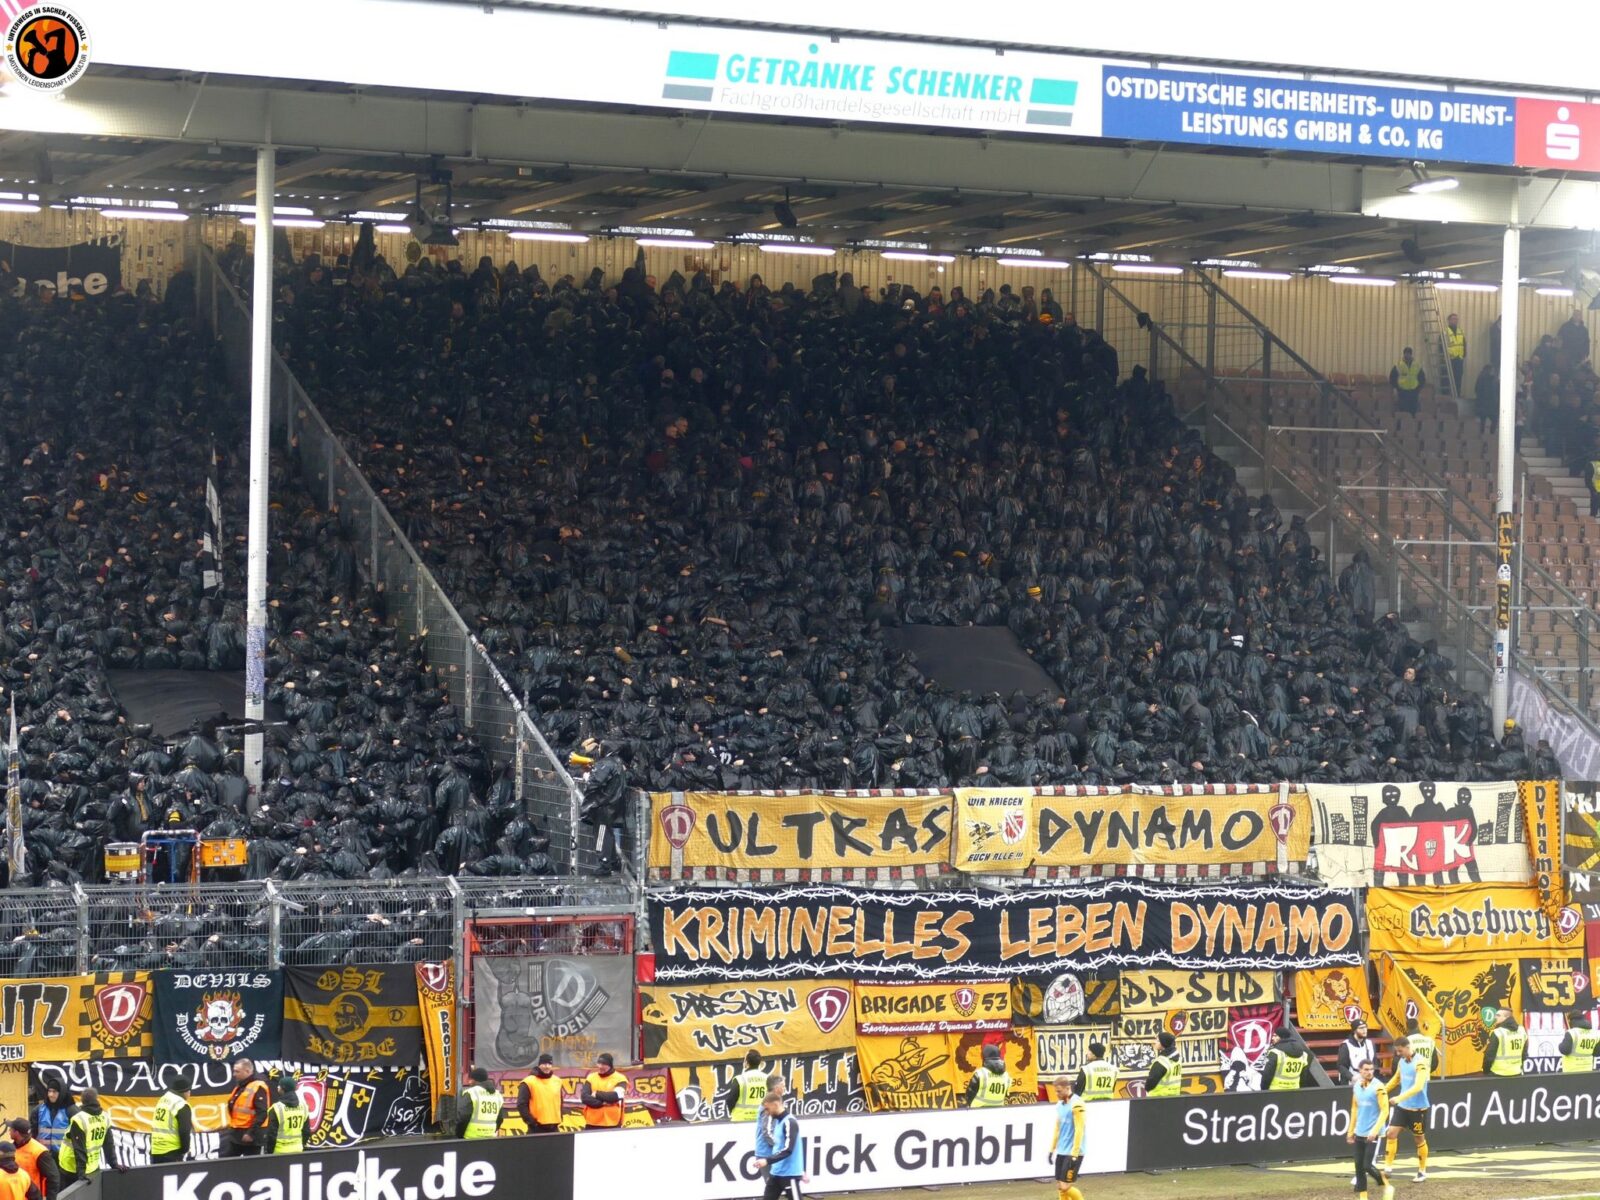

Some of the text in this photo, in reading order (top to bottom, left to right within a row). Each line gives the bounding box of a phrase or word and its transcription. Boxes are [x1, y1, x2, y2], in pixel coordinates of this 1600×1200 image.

[886, 66, 1023, 102] SCHENKER
[720, 88, 1021, 124] Fachgroßhandelsgesellschaft mbH
[1106, 76, 1513, 127] OSTDEUTSCHE SICHERHEITS- UND DIENST-
[1181, 110, 1444, 150] LEISTUNGS GMBH & CO. KG
[967, 797, 1023, 806] WIR KRIEGEN
[705, 804, 950, 860] ULTRAS
[1038, 805, 1265, 855] DYNAMO
[967, 852, 991, 862] EUCH
[992, 851, 1014, 860] ALLE
[663, 900, 1354, 964] KRIMINELLES LEBEN DYNAMO
[1410, 897, 1552, 941] Radeburg
[173, 972, 272, 990] DEVILS
[1541, 974, 1576, 1006] 53
[0, 983, 70, 1039] ITZ
[670, 987, 797, 1023] DRESDEN
[861, 993, 947, 1014] BRIGADE
[982, 992, 1008, 1012] 53
[91, 1018, 146, 1048] DRESDEN
[176, 1012, 208, 1055] Dynamo
[229, 1013, 265, 1056] Dresden
[693, 1020, 785, 1053] WEST
[861, 1019, 1008, 1034] Sportgemeinschaft Dynamo Dresden
[1190, 1009, 1227, 1032] SGD
[634, 1075, 667, 1094] 53
[750, 1087, 765, 1099] 276
[989, 1082, 1005, 1095] 401
[1096, 1077, 1111, 1089] 472
[481, 1101, 498, 1114] 339
[703, 1122, 1034, 1183] Kolick GmbH
[162, 1150, 497, 1200] Koalick.de
